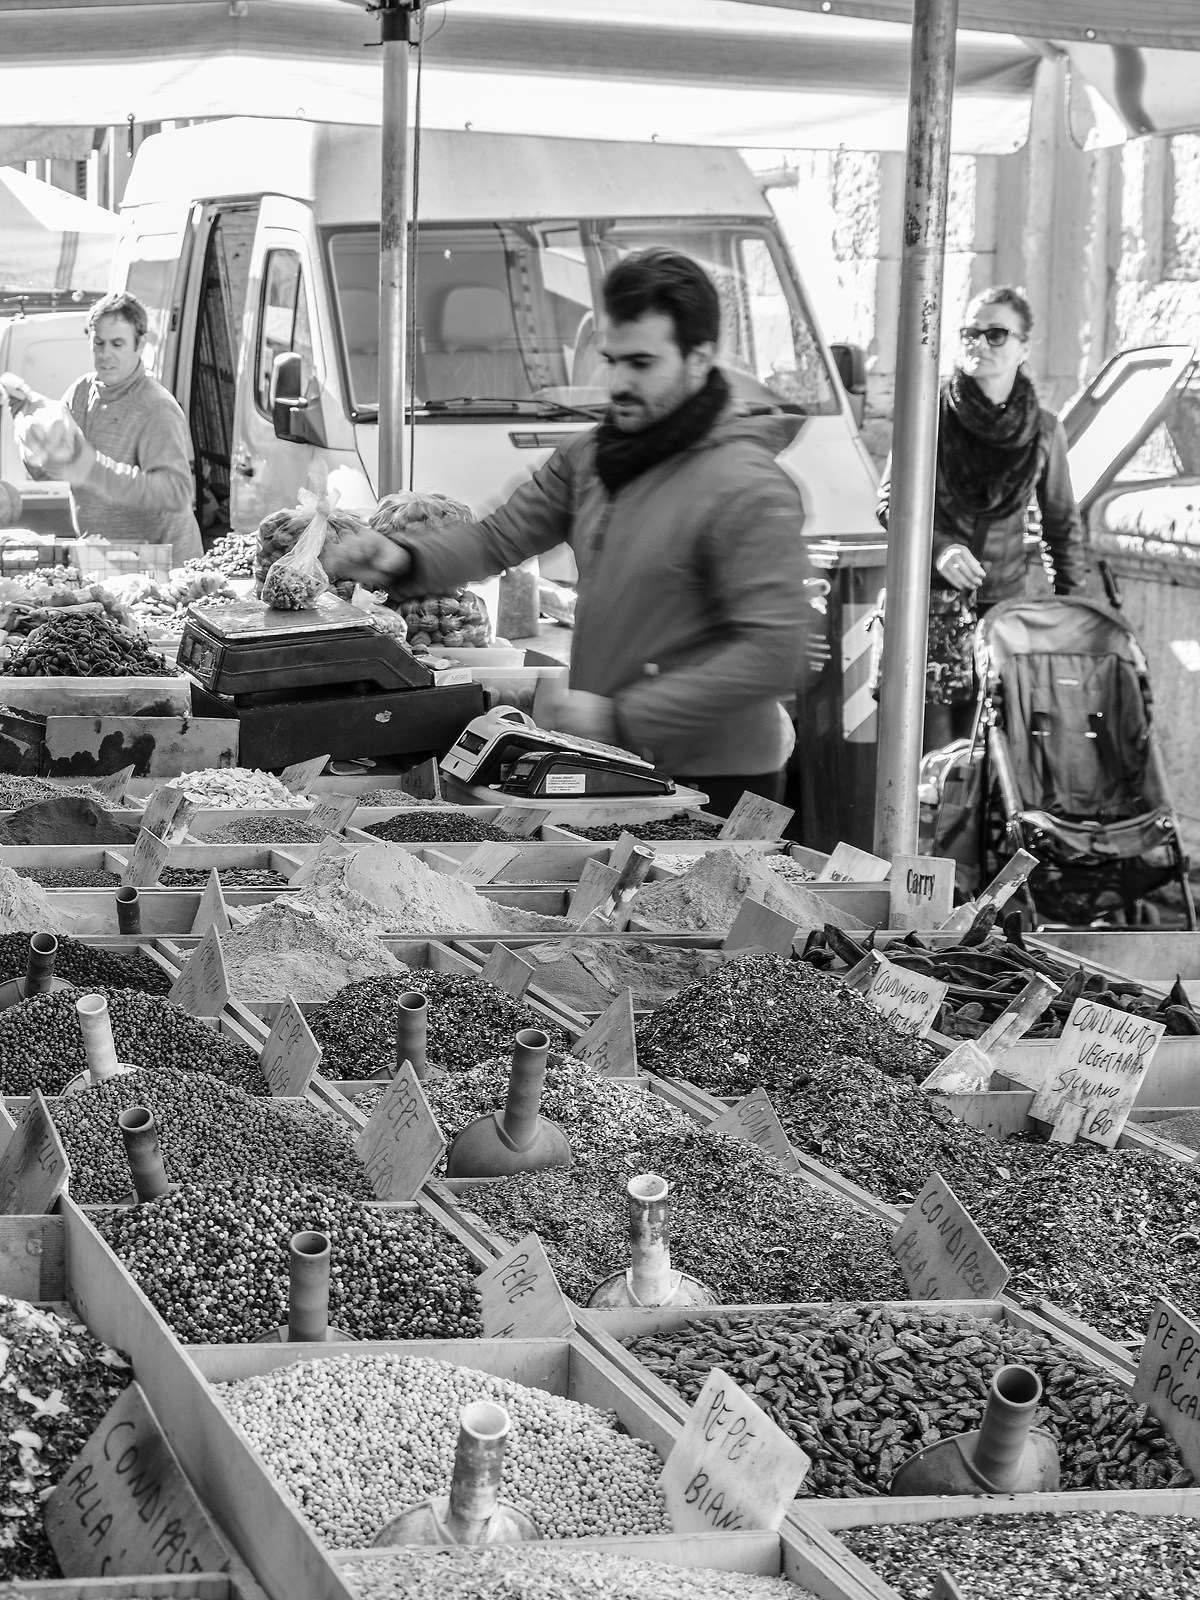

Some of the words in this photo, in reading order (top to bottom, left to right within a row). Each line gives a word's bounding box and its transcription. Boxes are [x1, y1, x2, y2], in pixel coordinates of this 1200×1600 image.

[308, 803, 341, 821] ANETO
[906, 868, 936, 901] Carry
[274, 1004, 303, 1055] PEPE
[1073, 1004, 1157, 1057] CONDIMENTO
[383, 1076, 419, 1142] PEPE
[1088, 1108, 1114, 1136] BIO
[492, 1253, 538, 1304] PEPE
[1153, 1311, 1200, 1380] PEPE
[1153, 1364, 1200, 1421] PICCA
[702, 1389, 756, 1461] PEPE
[67, 1464, 113, 1546] ALLA
